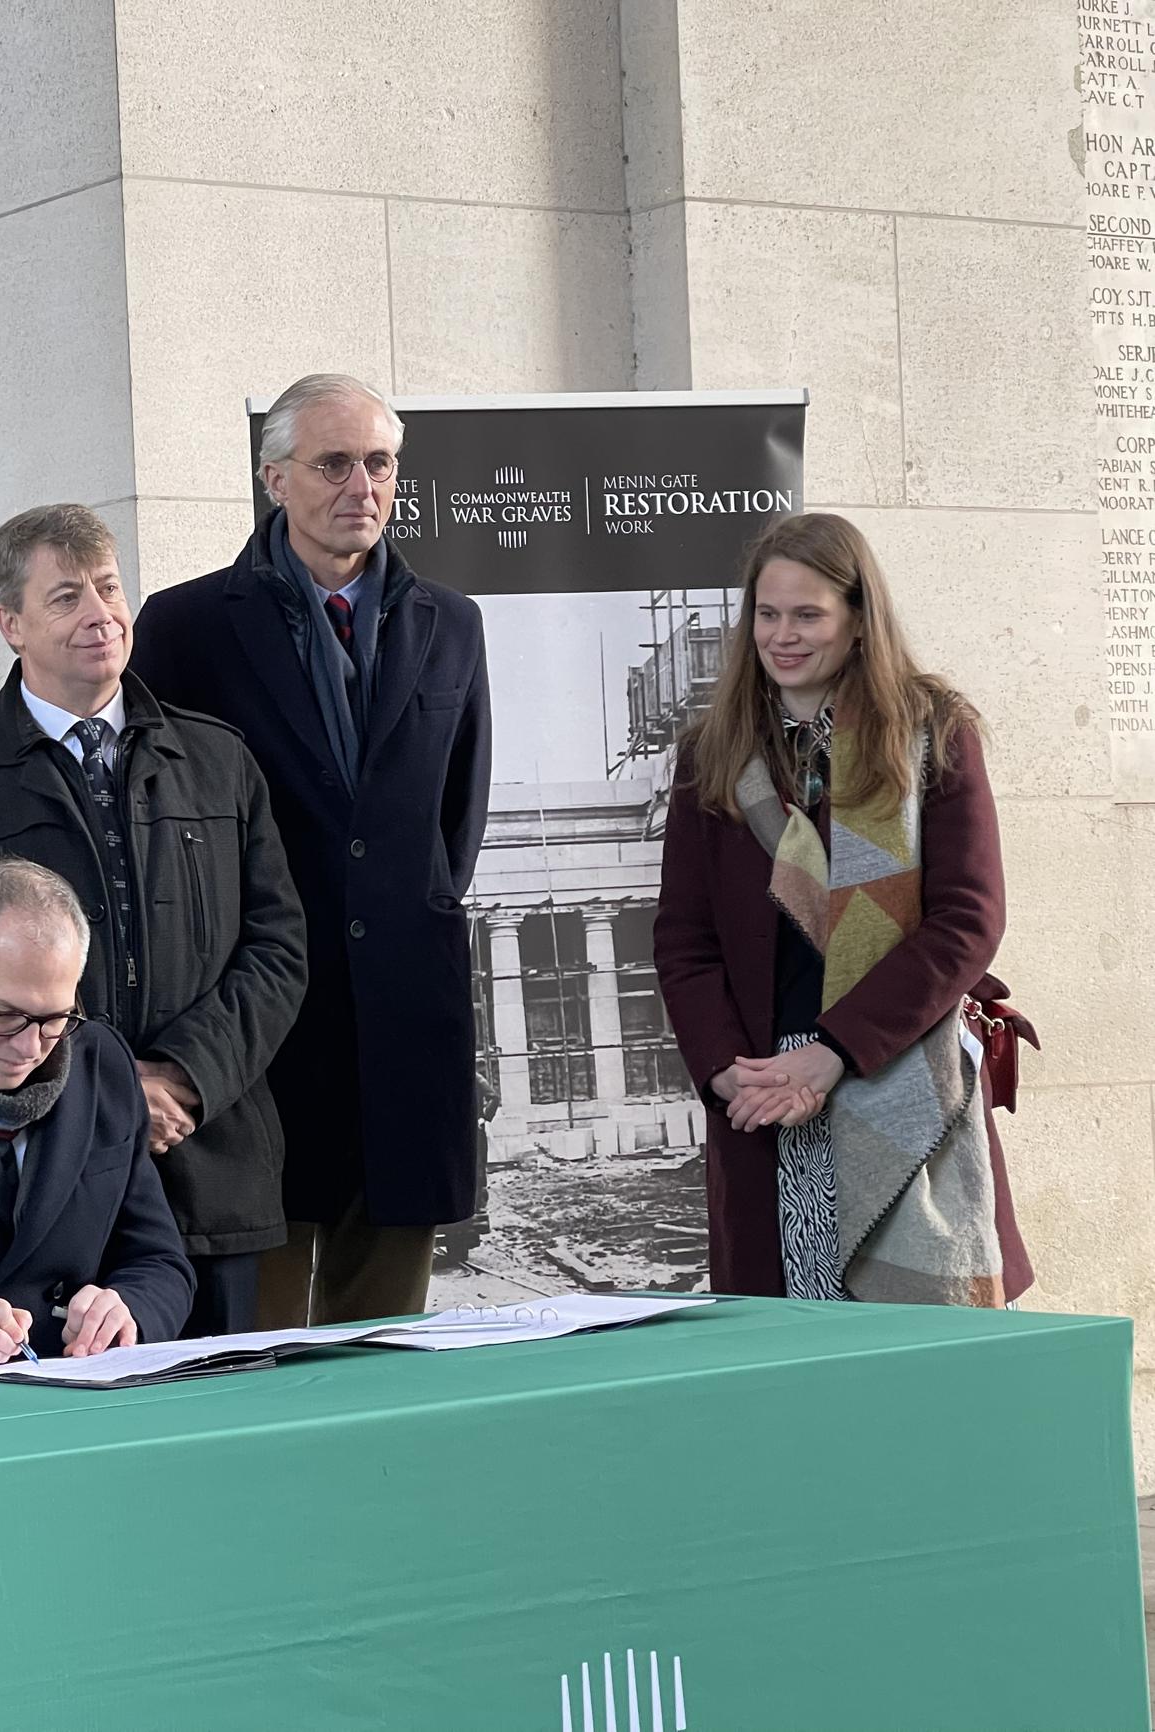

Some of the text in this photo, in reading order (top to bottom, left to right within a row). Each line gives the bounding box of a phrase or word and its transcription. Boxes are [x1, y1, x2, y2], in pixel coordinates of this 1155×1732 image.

[1089, 214, 1151, 236] SECOND
[396, 479, 419, 493] ATE
[603, 474, 698, 489] MENIN GATE
[450, 491, 571, 505] COMMONWEALTH
[603, 490, 793, 516] RESTORATION
[393, 497, 420, 521] TS
[450, 505, 572, 524] WAR GRAVES
[383, 524, 421, 539] TION
[605, 520, 654, 534] WORK
[1102, 528, 1146, 546] LANCE
